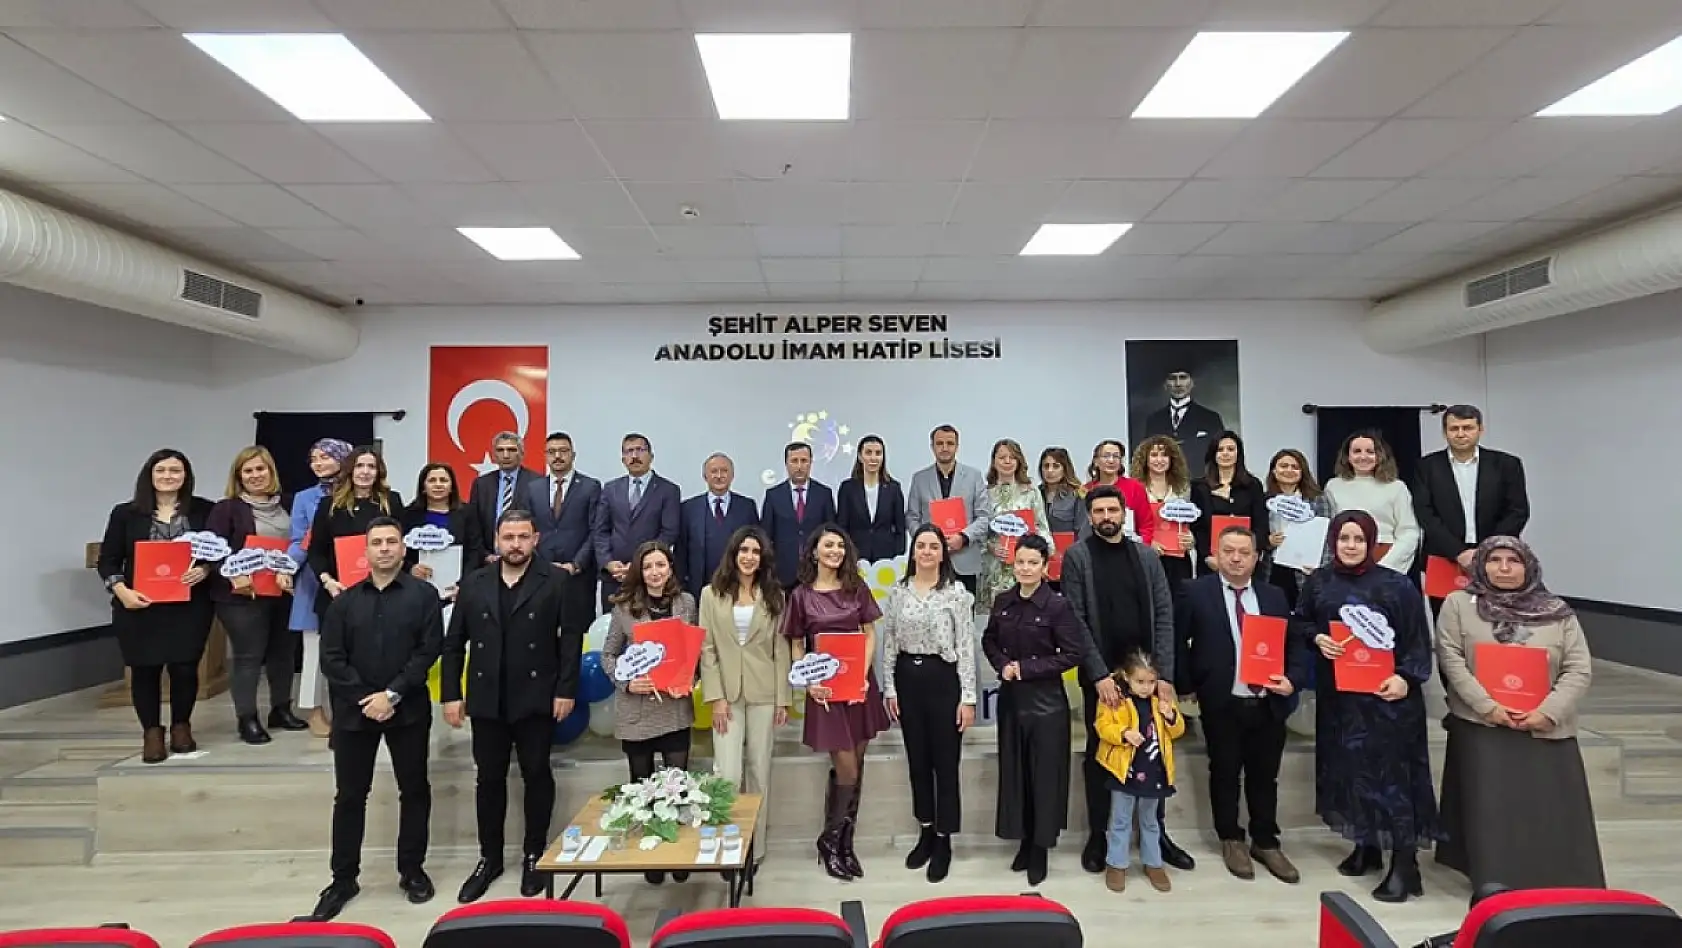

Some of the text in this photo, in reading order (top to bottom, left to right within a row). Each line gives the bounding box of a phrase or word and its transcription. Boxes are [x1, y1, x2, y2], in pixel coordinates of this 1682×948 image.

[708, 313, 947, 336] ŞEHİT ALPER SEVEN
[655, 337, 1002, 361] ANADOLU İMAM HATİP LİSESİ
